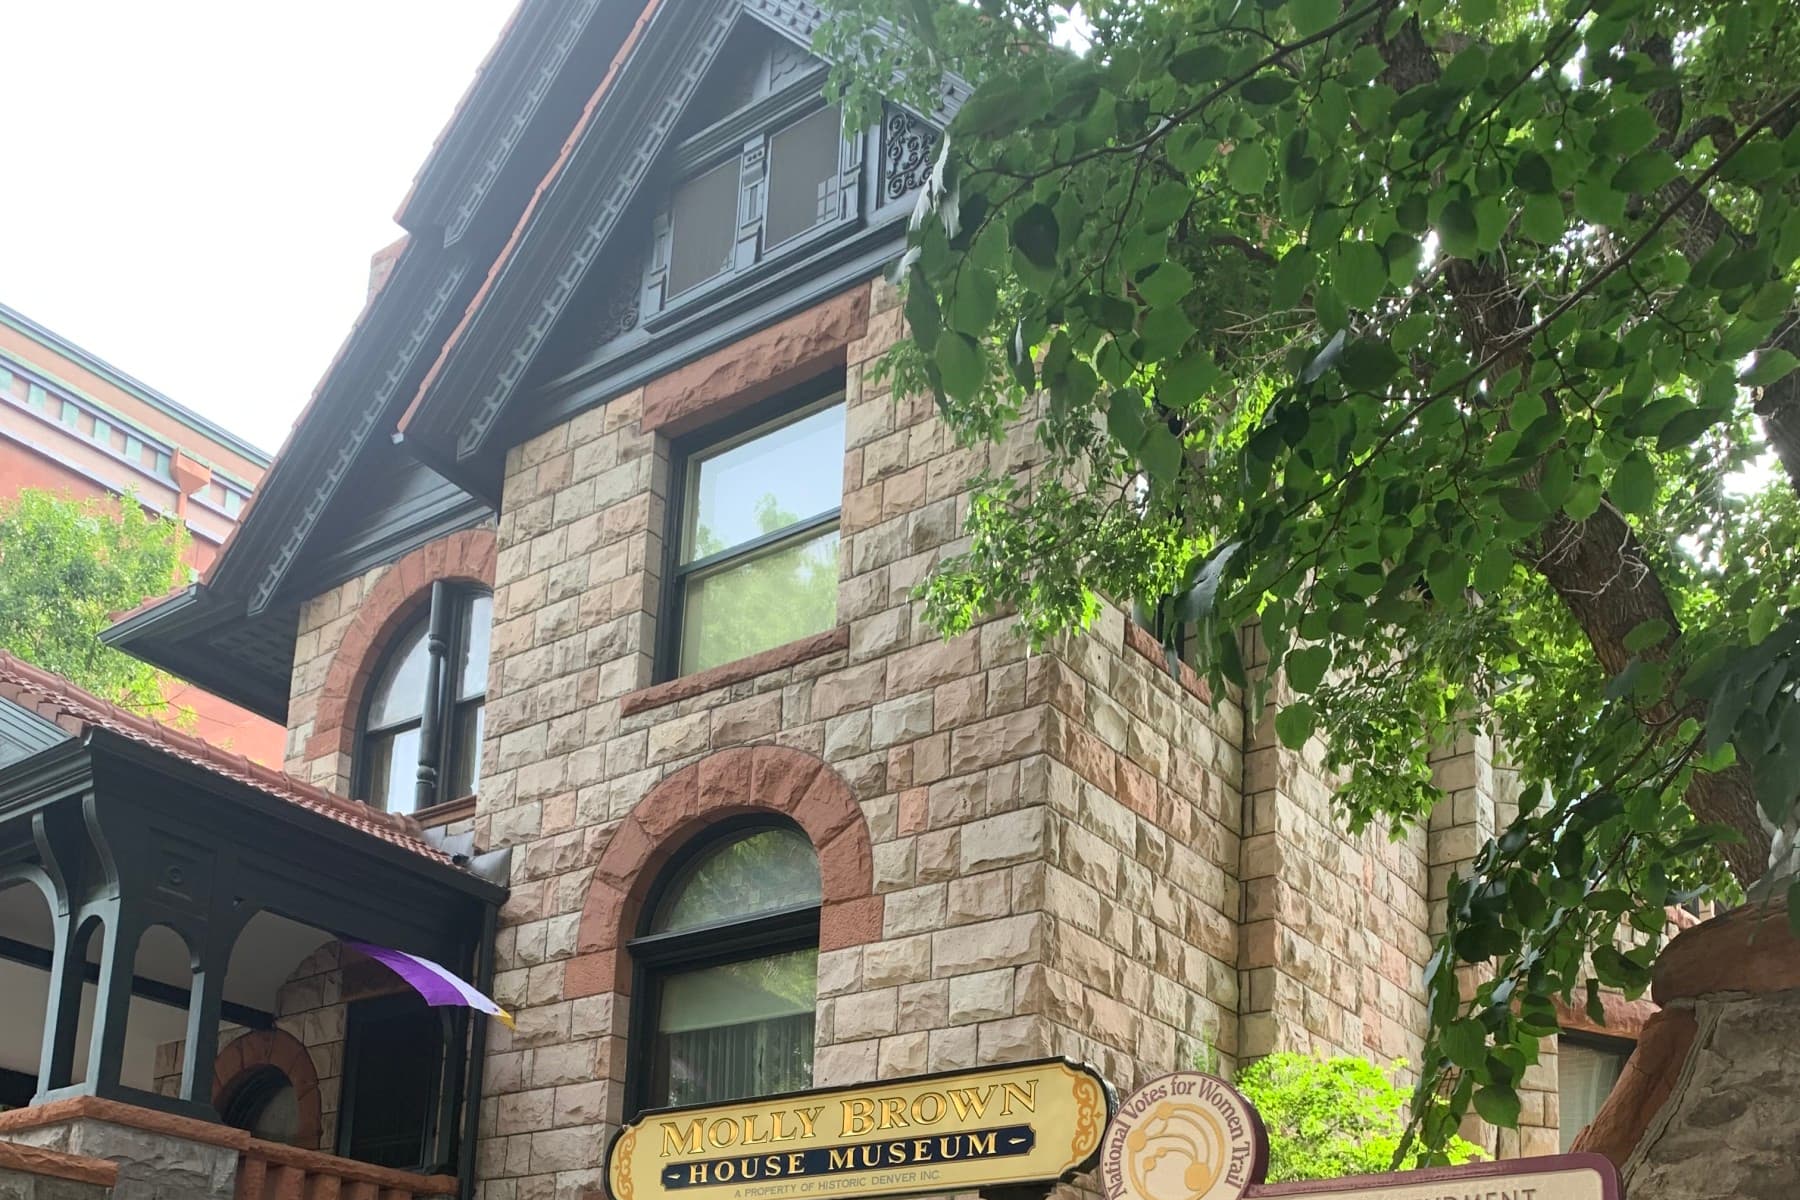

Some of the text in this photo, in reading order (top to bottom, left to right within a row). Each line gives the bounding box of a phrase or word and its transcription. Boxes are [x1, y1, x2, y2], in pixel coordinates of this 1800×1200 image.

[659, 1079, 1039, 1157] MOLLY BROWN
[1104, 1075, 1250, 1200] National Votes for Women Trail
[688, 1131, 998, 1185] HOUSE MUSEUM
[734, 1190, 741, 1198] A
[744, 1184, 797, 1198] PROPERTY
[800, 1182, 815, 1192] OF
[818, 1176, 867, 1191] HISTORIC
[871, 1172, 917, 1186] DENVER
